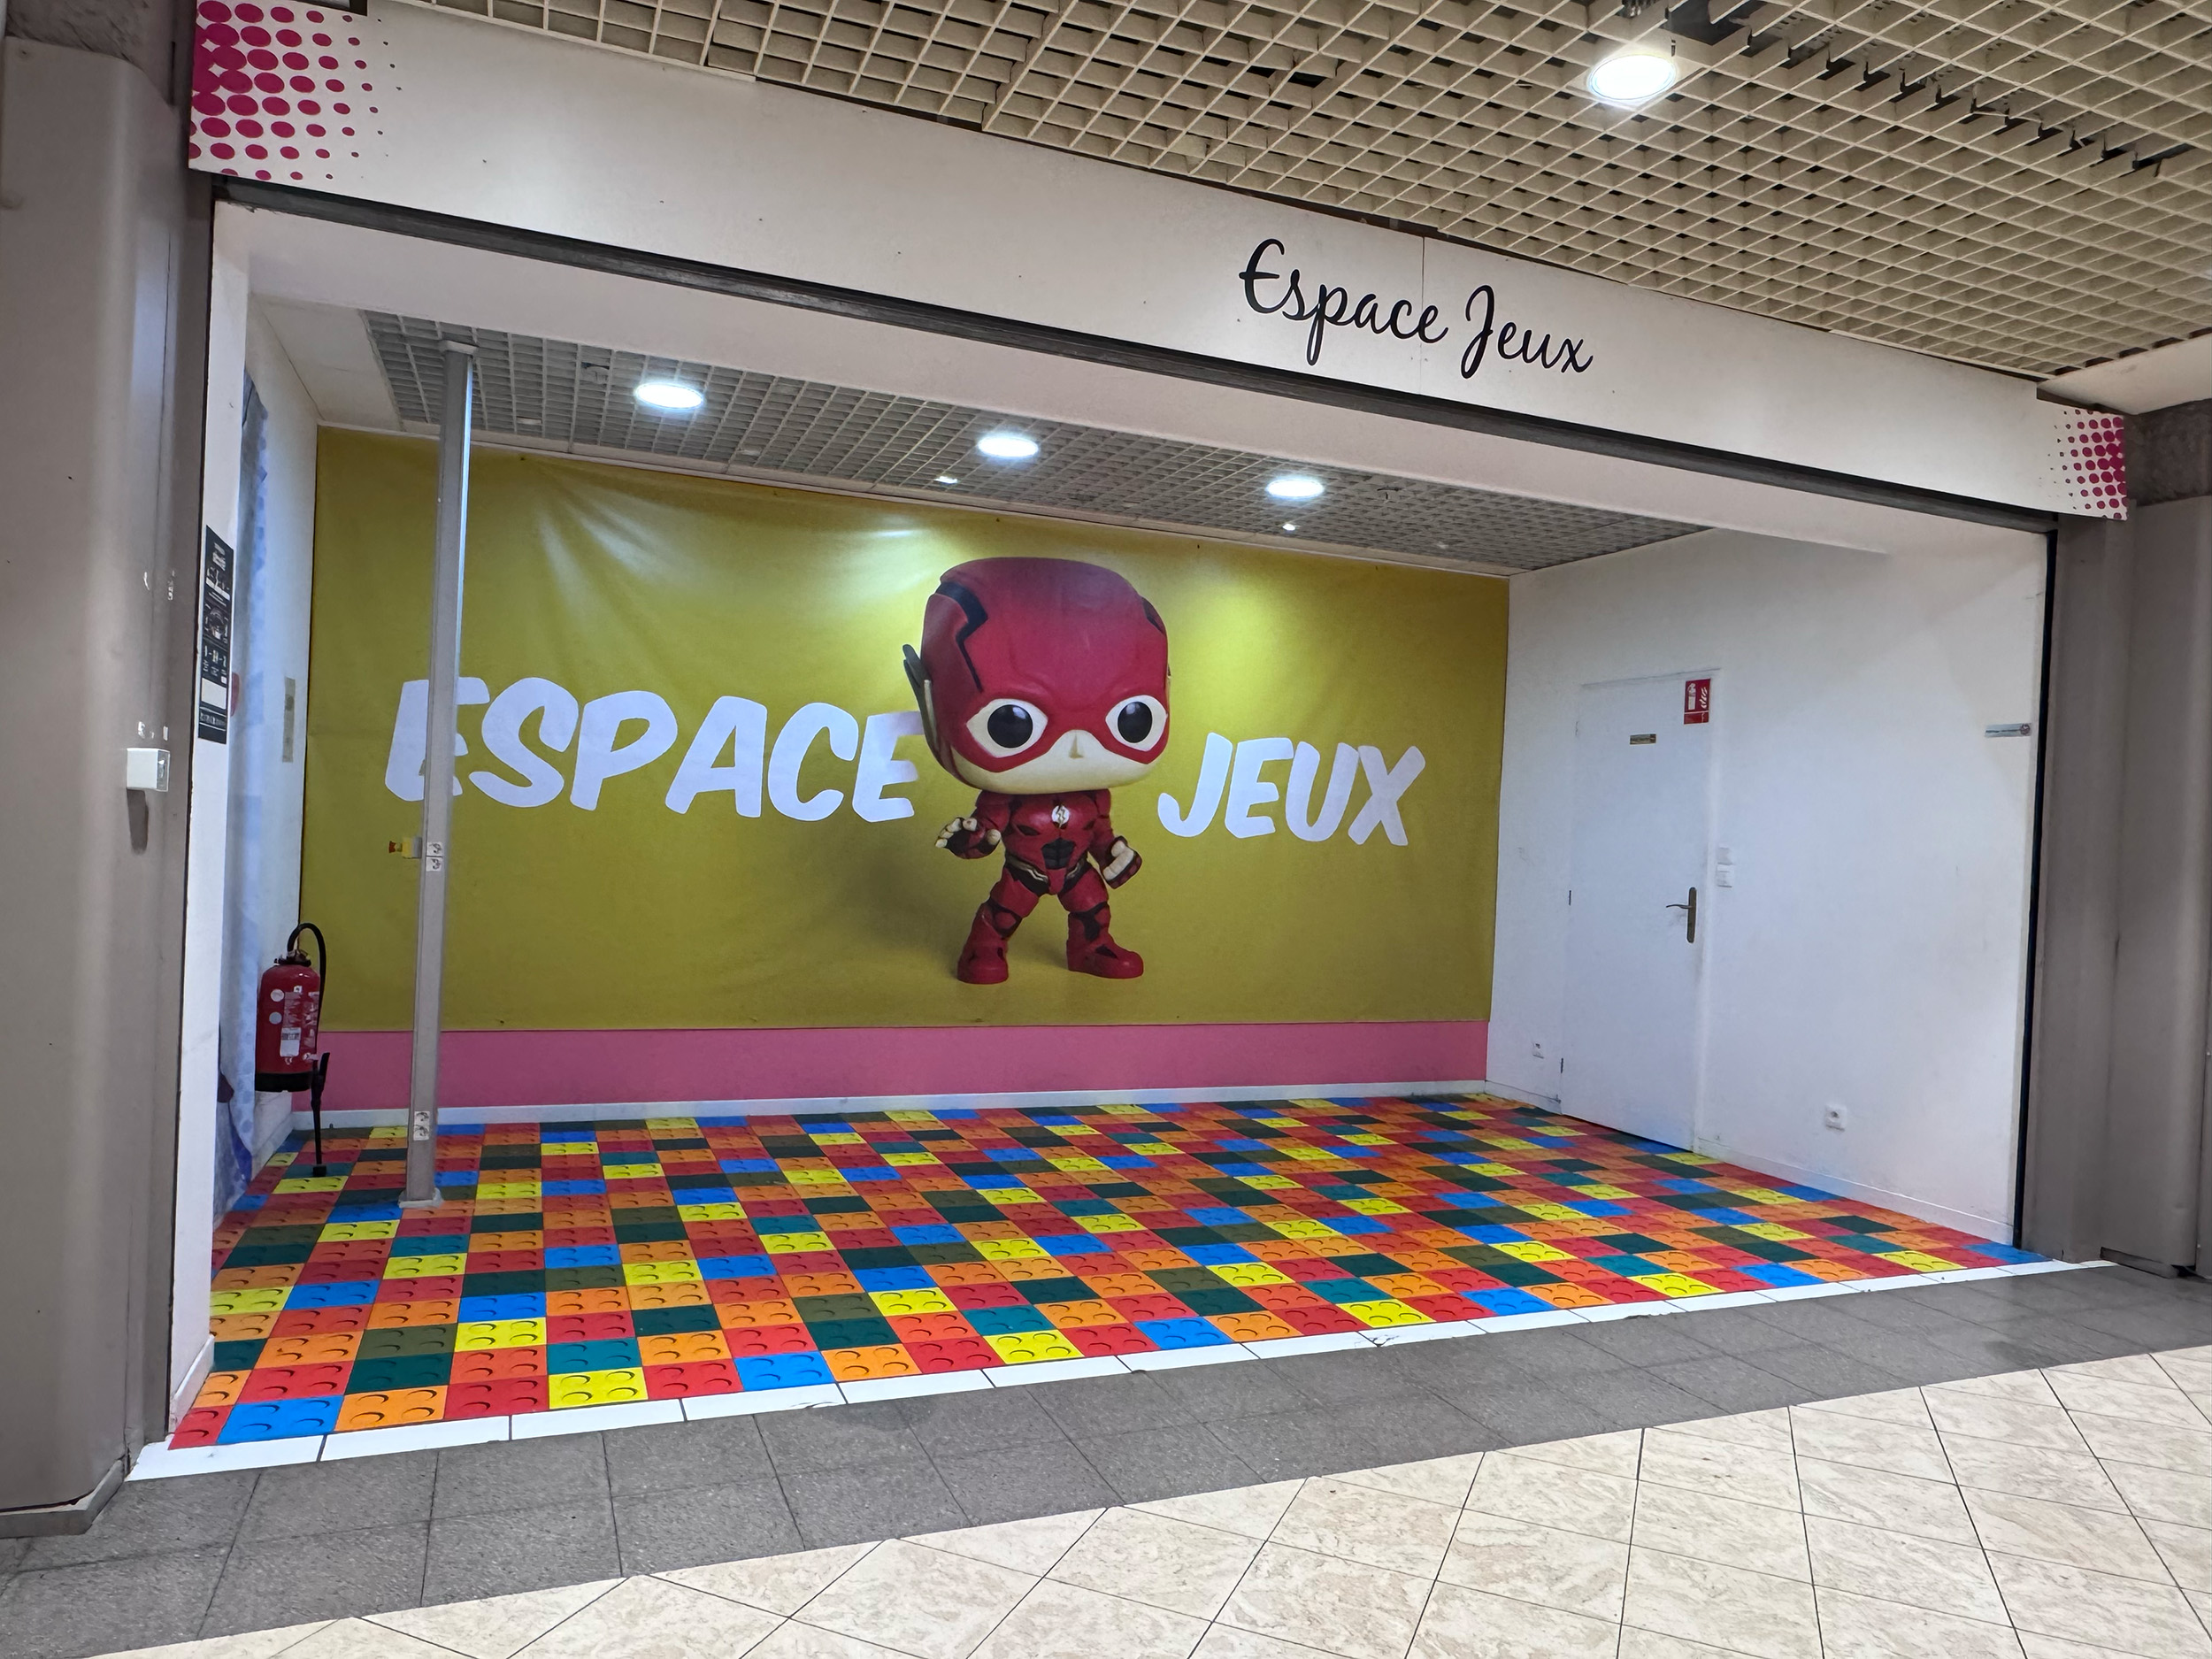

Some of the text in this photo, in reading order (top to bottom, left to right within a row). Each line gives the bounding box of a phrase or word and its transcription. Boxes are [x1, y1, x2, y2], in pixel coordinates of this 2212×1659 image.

[1239, 238, 1594, 379] Espace Jeux
[385, 676, 1425, 846] ESPACE JEUX
